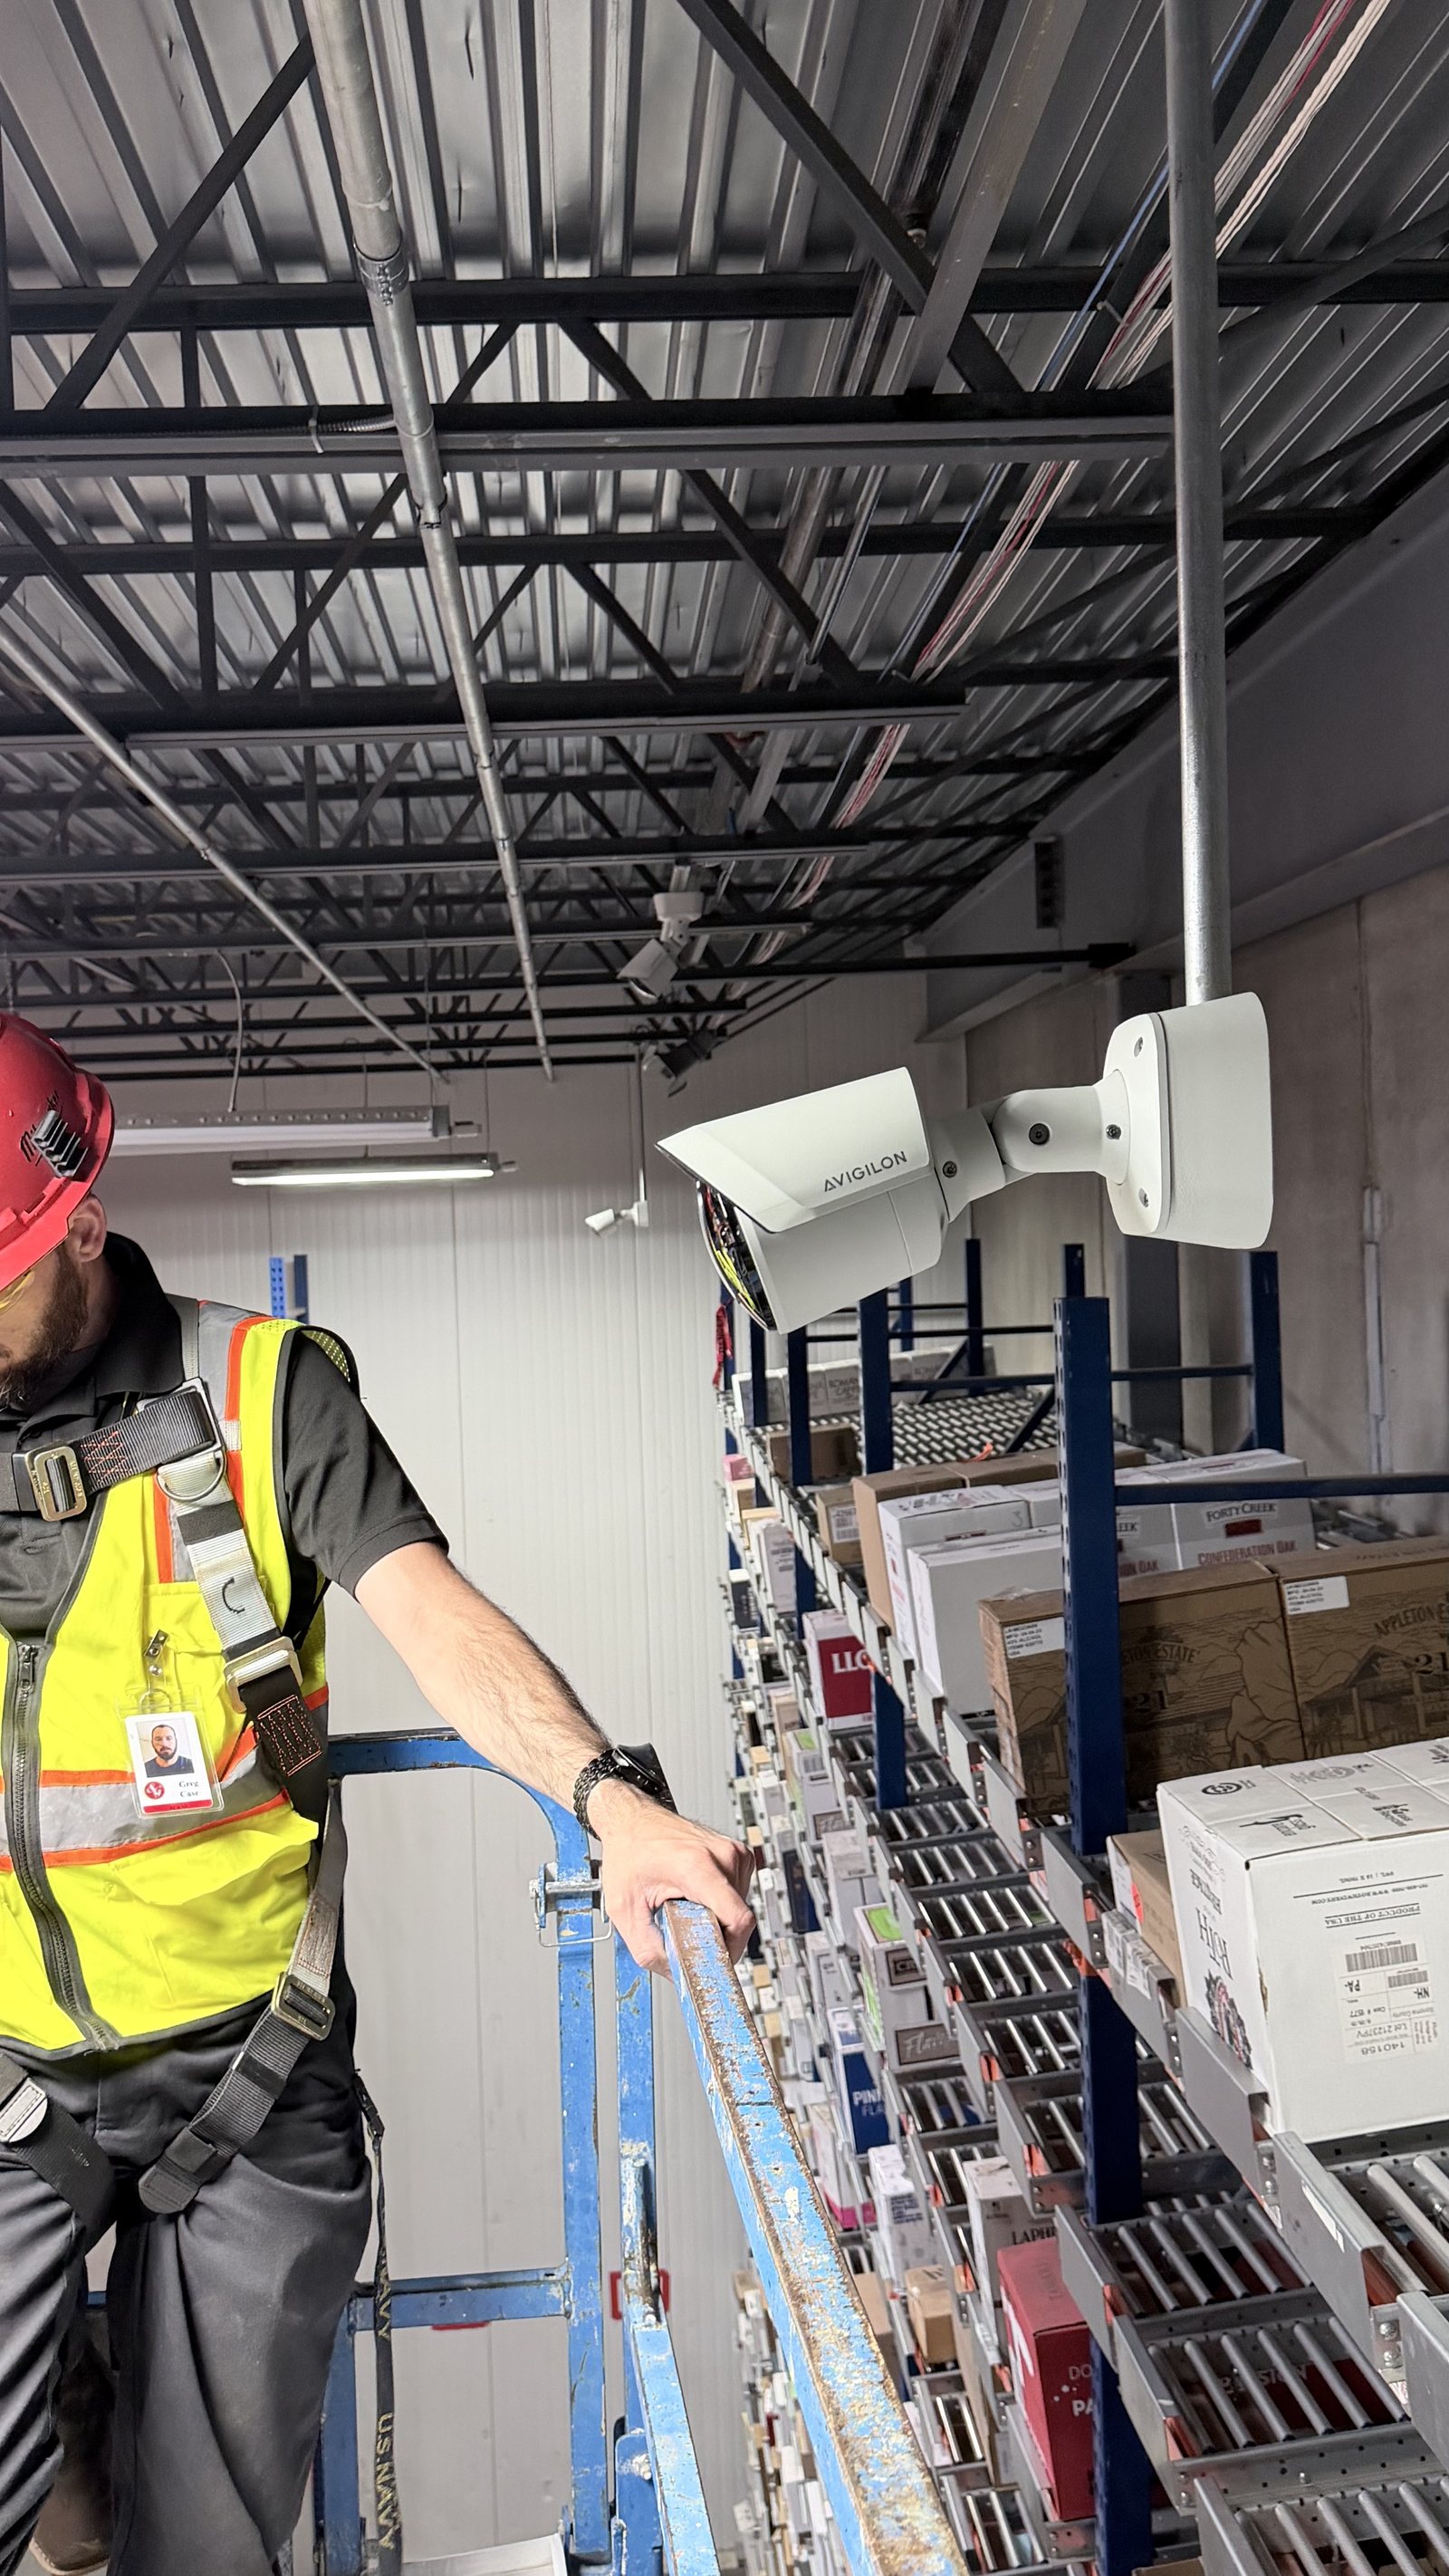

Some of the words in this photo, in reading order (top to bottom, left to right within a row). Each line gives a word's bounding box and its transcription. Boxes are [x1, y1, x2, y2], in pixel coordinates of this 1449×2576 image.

[822, 1150, 908, 1193] AVIGILON
[1012, 1511, 1022, 1527] 3
[1206, 1506, 1239, 1522] FORTY
[1241, 1503, 1276, 1514] CREEK
[1116, 1522, 1137, 1532] EEK
[1197, 1543, 1275, 1566] CONFEDERATION
[1276, 1541, 1297, 1553] OAK
[1138, 1560, 1159, 1574] OAK
[1374, 1605, 1437, 1636] APPLETON
[1346, 1914, 1363, 1923] THE
[1364, 1912, 1377, 1920] OF
[1378, 1906, 1420, 1918] PRODUCT
[1324, 1918, 1343, 1926] USA
